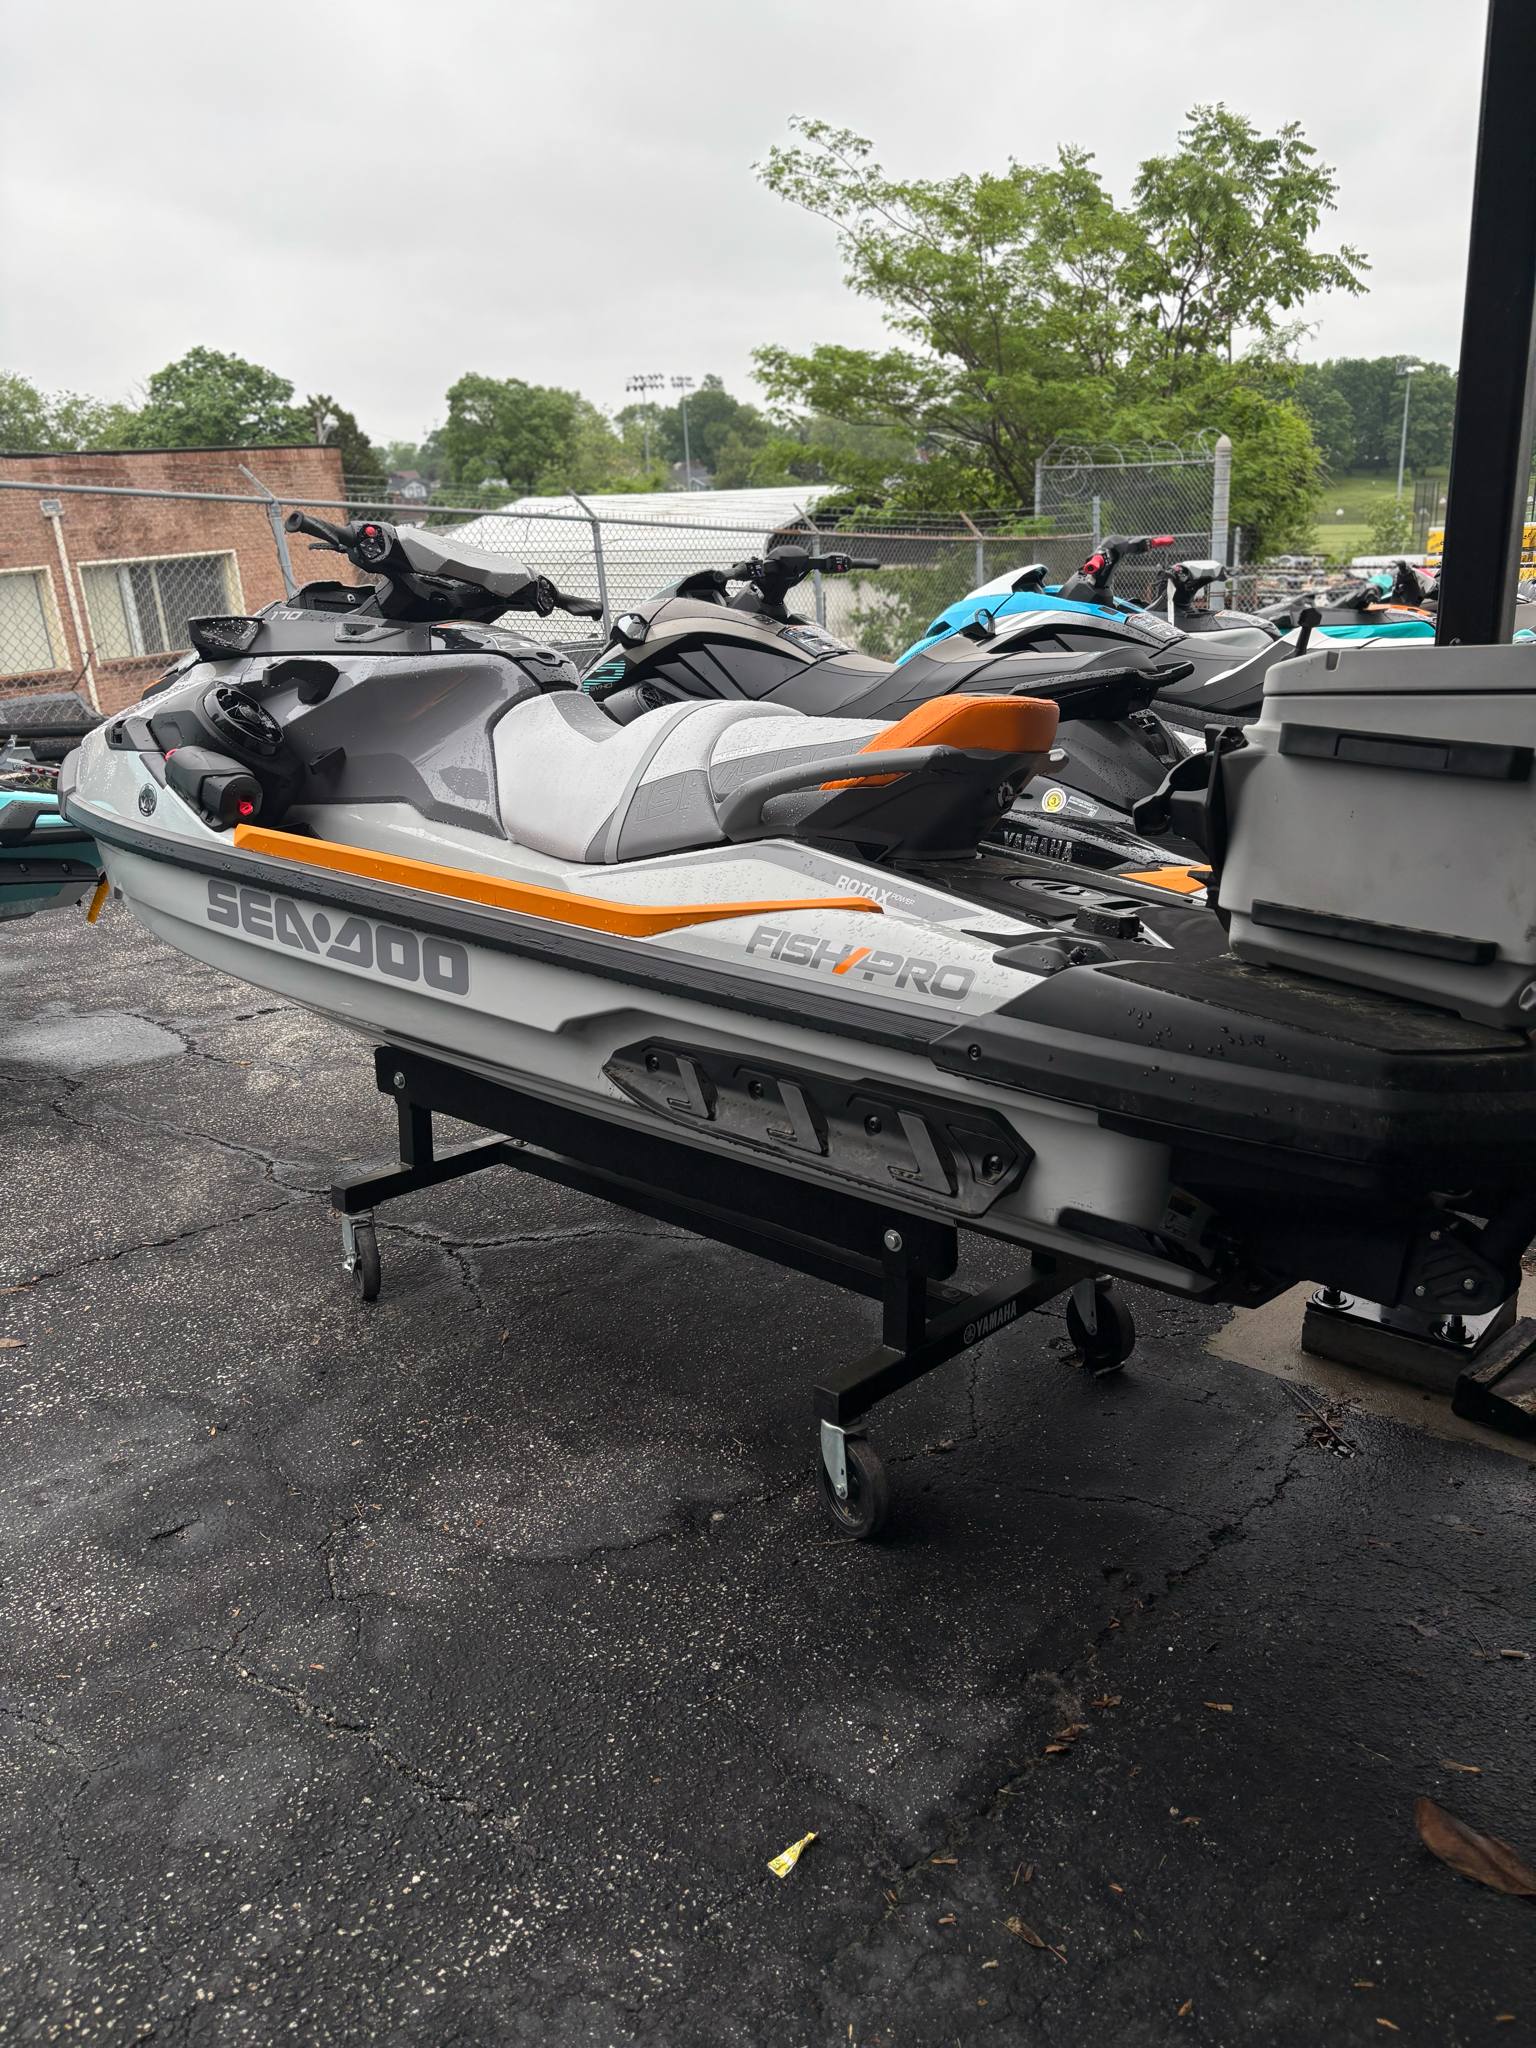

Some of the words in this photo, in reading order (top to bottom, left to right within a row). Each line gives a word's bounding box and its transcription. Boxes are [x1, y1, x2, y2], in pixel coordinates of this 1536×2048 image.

[270, 610, 303, 620] 170
[1003, 831, 1073, 863] YAMAHA
[834, 874, 893, 907] ROTAX
[976, 1300, 1017, 1337] YAMAHA
